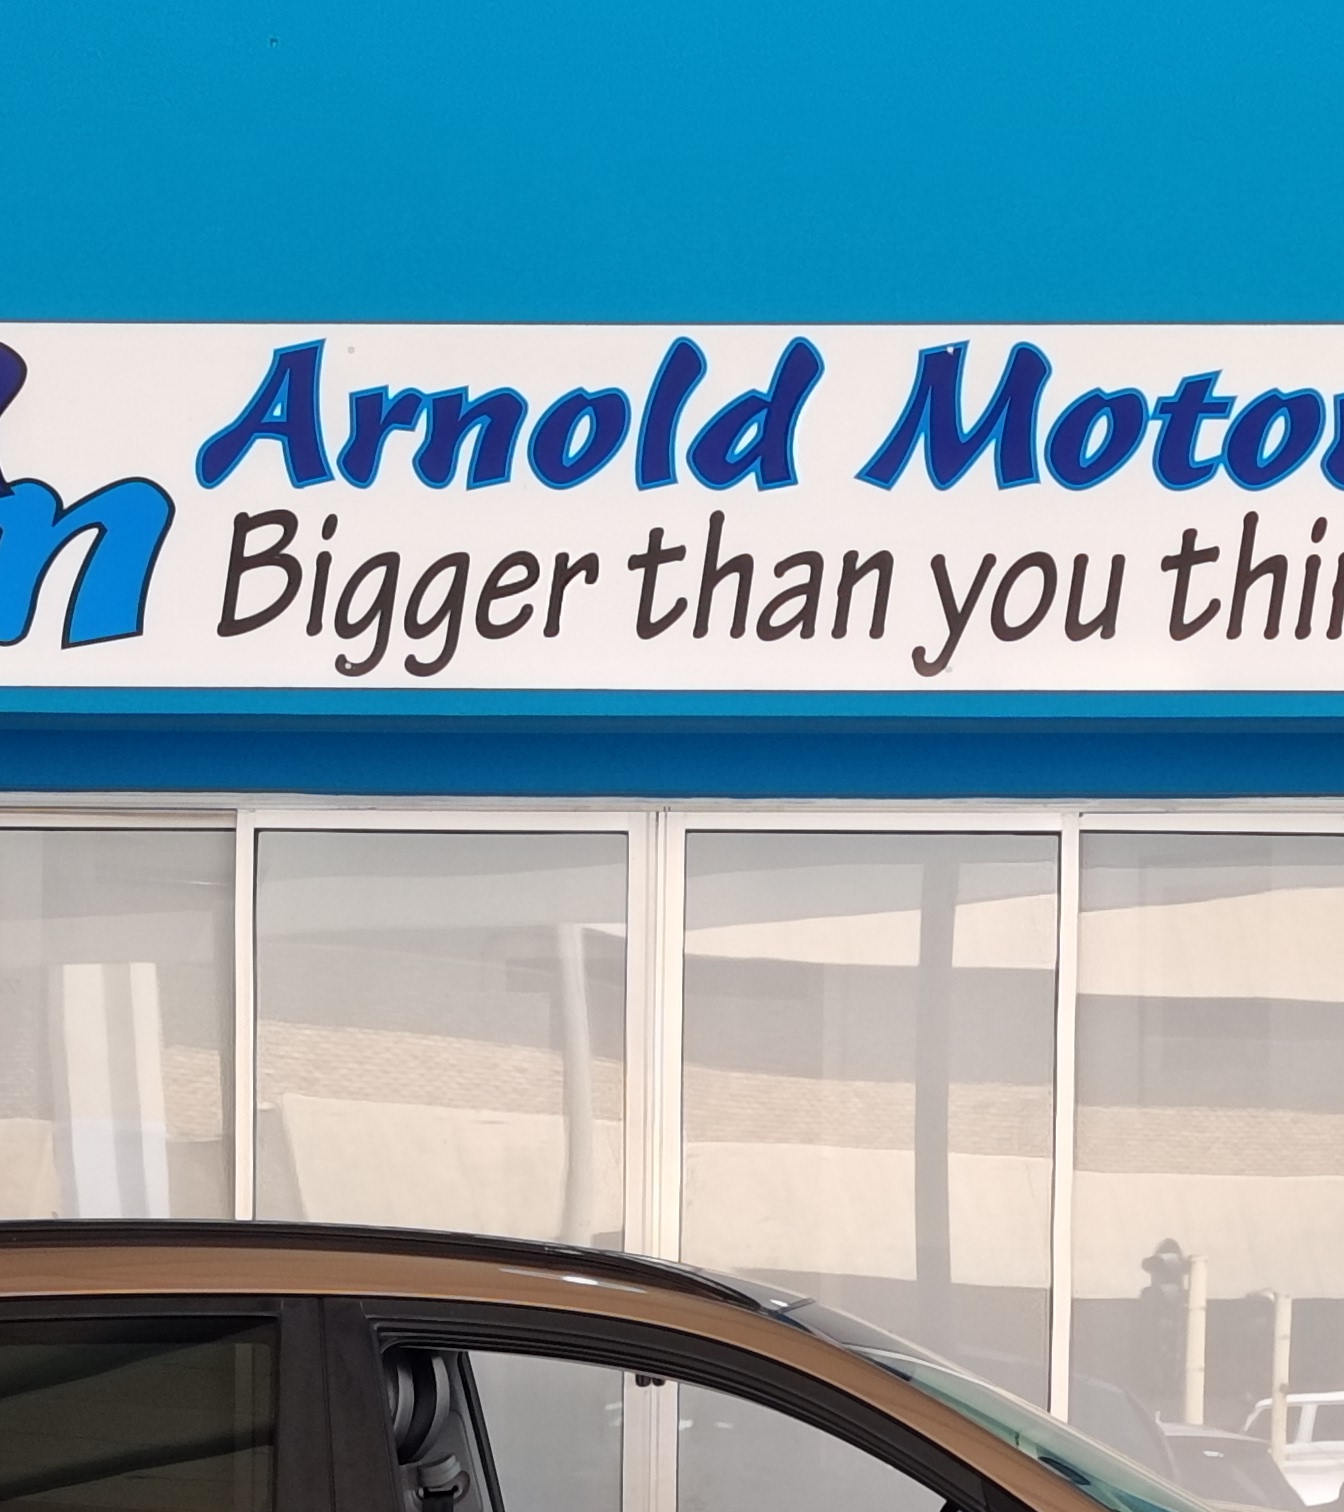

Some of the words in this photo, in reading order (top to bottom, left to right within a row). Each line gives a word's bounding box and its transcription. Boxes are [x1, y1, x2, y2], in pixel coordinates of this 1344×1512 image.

[196, 336, 824, 492] Arnold
[215, 509, 600, 675] Bigger
[626, 509, 895, 645] than
[912, 548, 1127, 677] you
